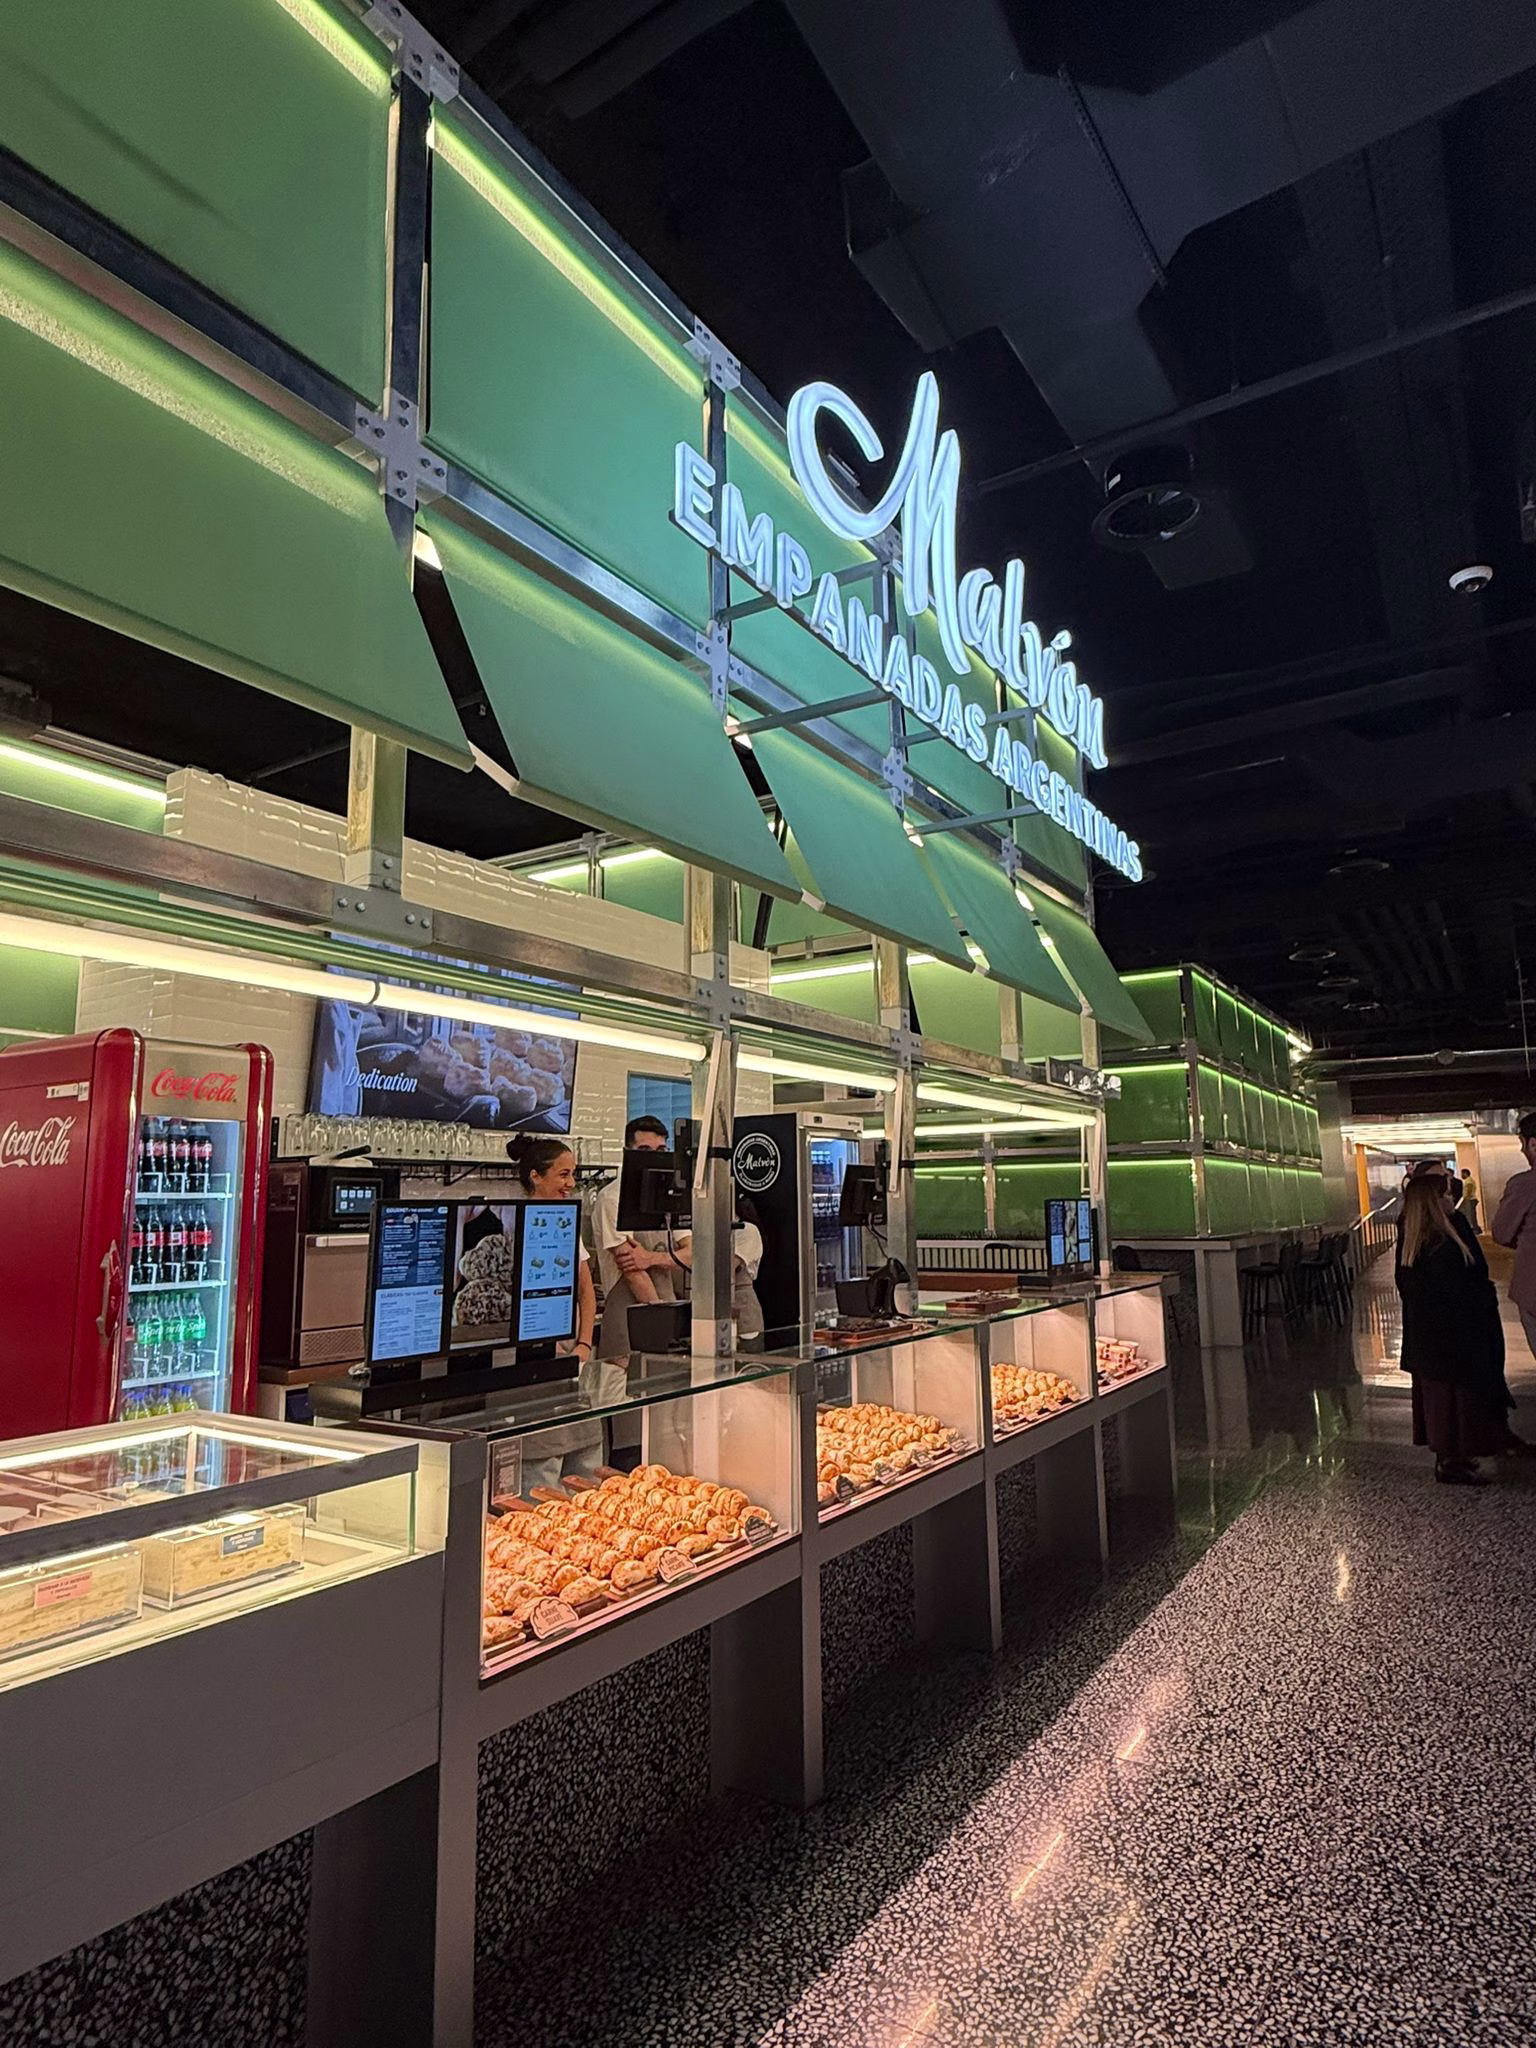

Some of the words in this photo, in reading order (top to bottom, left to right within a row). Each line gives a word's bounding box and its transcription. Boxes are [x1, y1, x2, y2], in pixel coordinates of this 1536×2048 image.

[787, 371, 1108, 769] Malvón
[675, 441, 988, 764] EMPANADAS
[989, 727, 1142, 882] ARGENTINAS
[151, 1068, 241, 1103] Coca-Cola
[345, 1067, 418, 1093] Dedication
[0, 1116, 77, 1168] Coca-Cola
